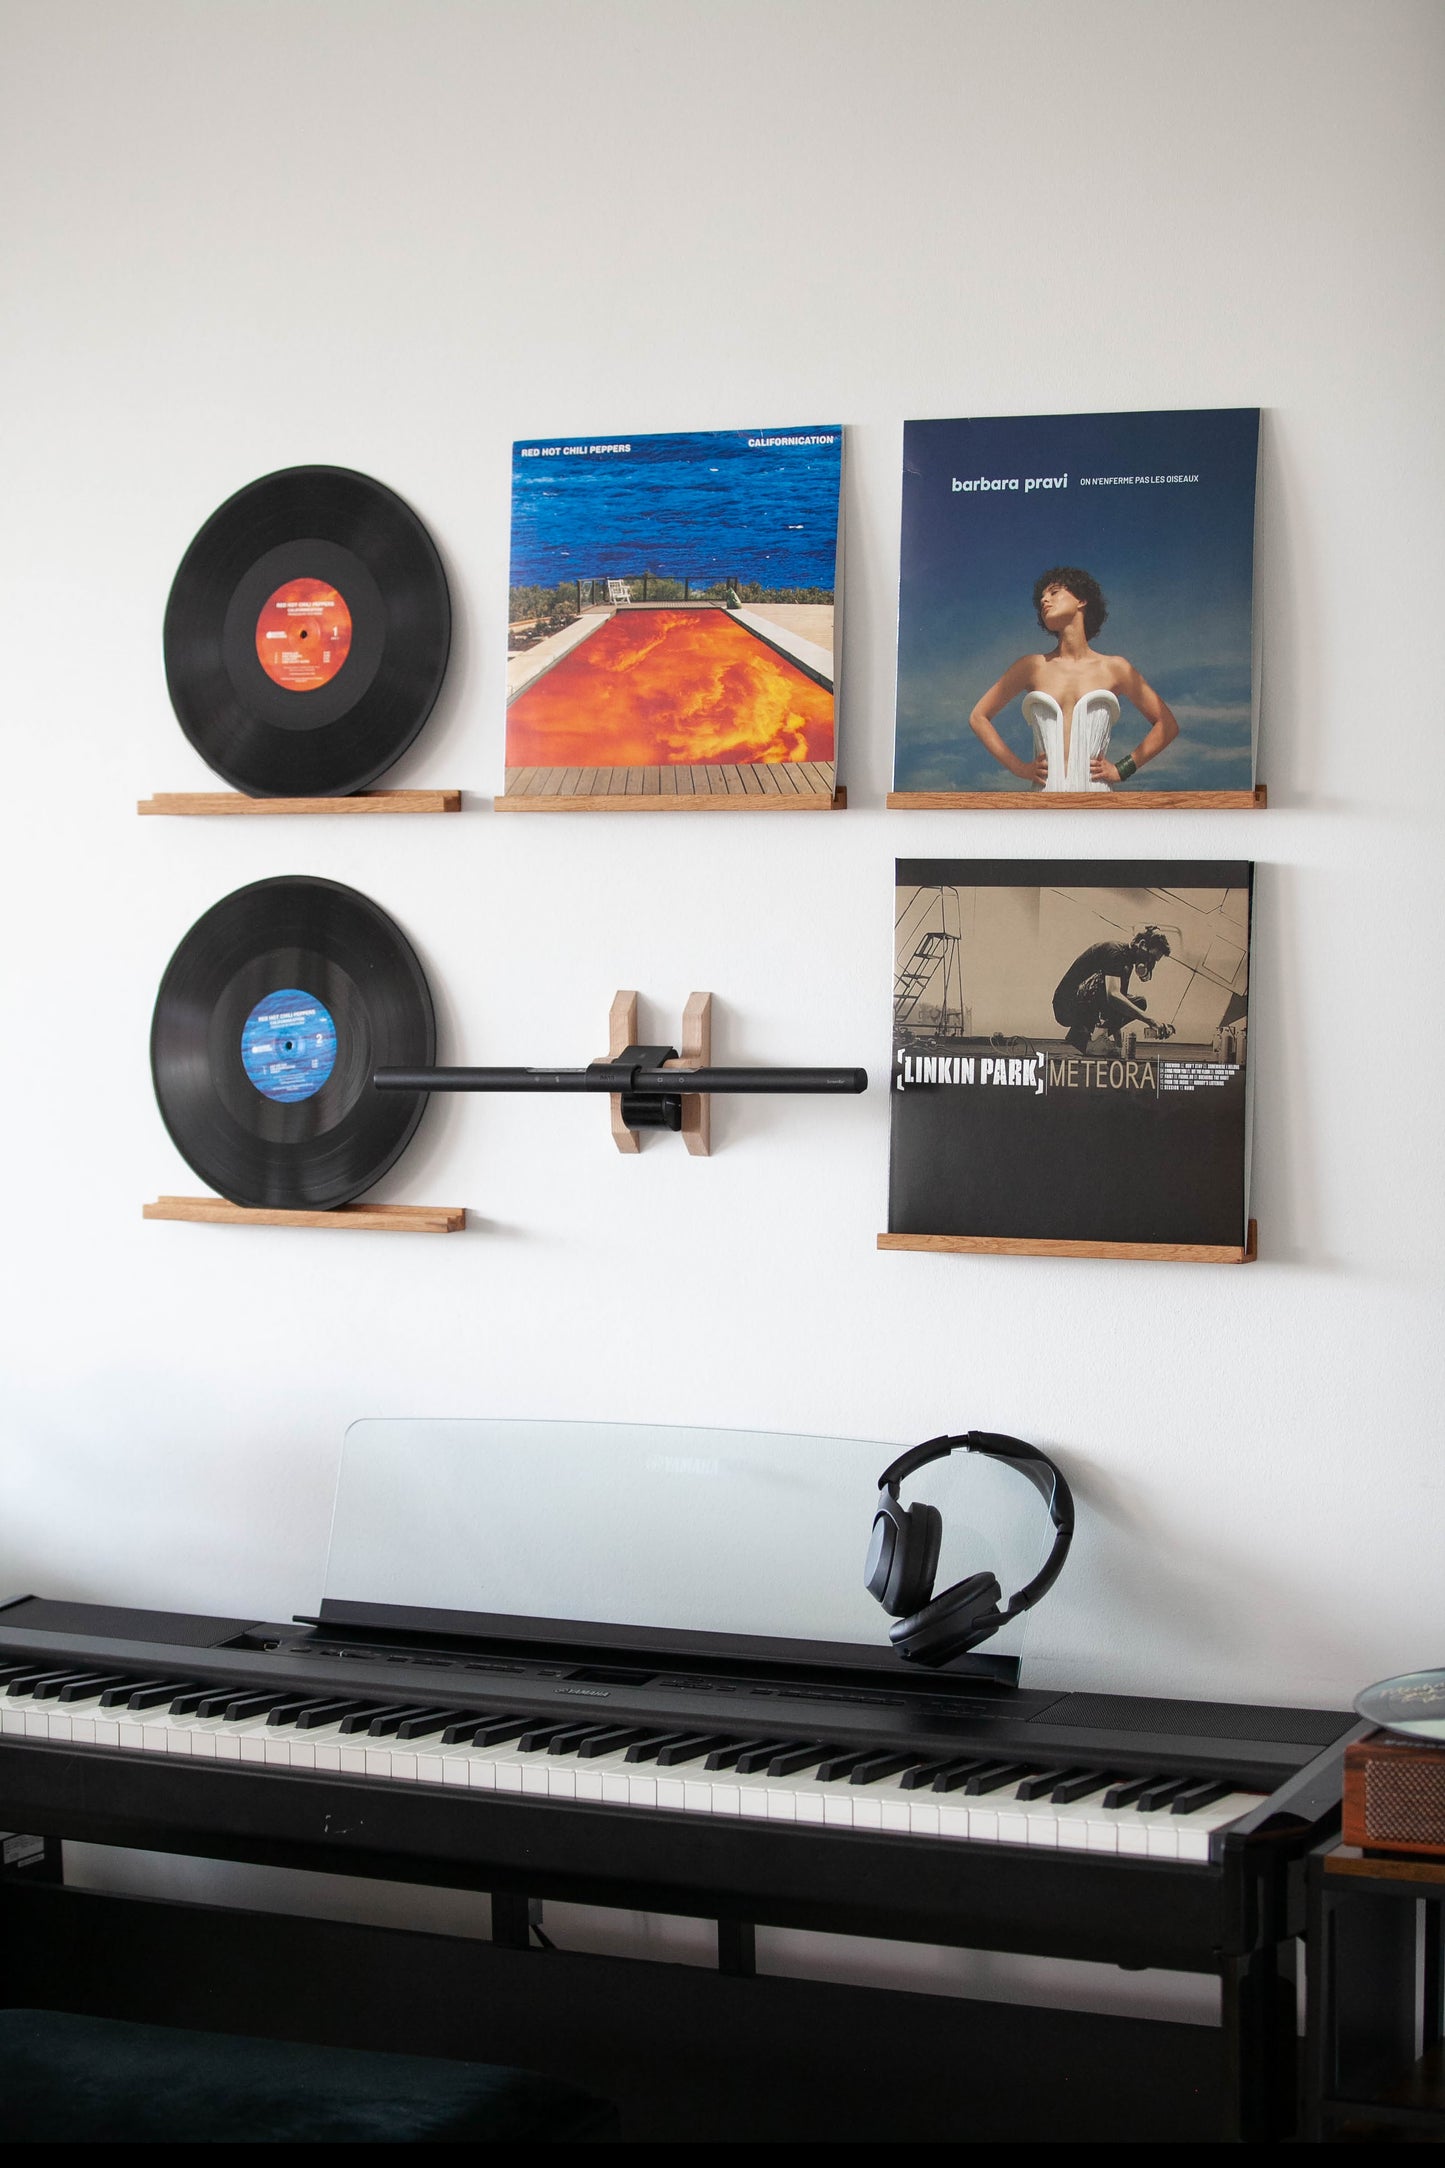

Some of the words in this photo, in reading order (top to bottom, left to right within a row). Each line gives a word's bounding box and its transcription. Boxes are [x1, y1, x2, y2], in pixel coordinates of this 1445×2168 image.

[748, 436, 834, 447] CALIFORNICATION
[521, 449, 540, 457] RED
[542, 447, 561, 456] HOT
[563, 446, 588, 455] CHILI
[590, 444, 631, 454] PEPPERS
[952, 477, 1019, 492] barbara
[1025, 473, 1068, 493] pravi
[1080, 478, 1091, 486] ON
[1092, 476, 1134, 485] N'ENFERME
[1135, 476, 1150, 484] PAS
[1151, 476, 1165, 484] LES
[1166, 474, 1199, 483] OISEAUX
[1050, 1060, 1156, 1090] METEORA
